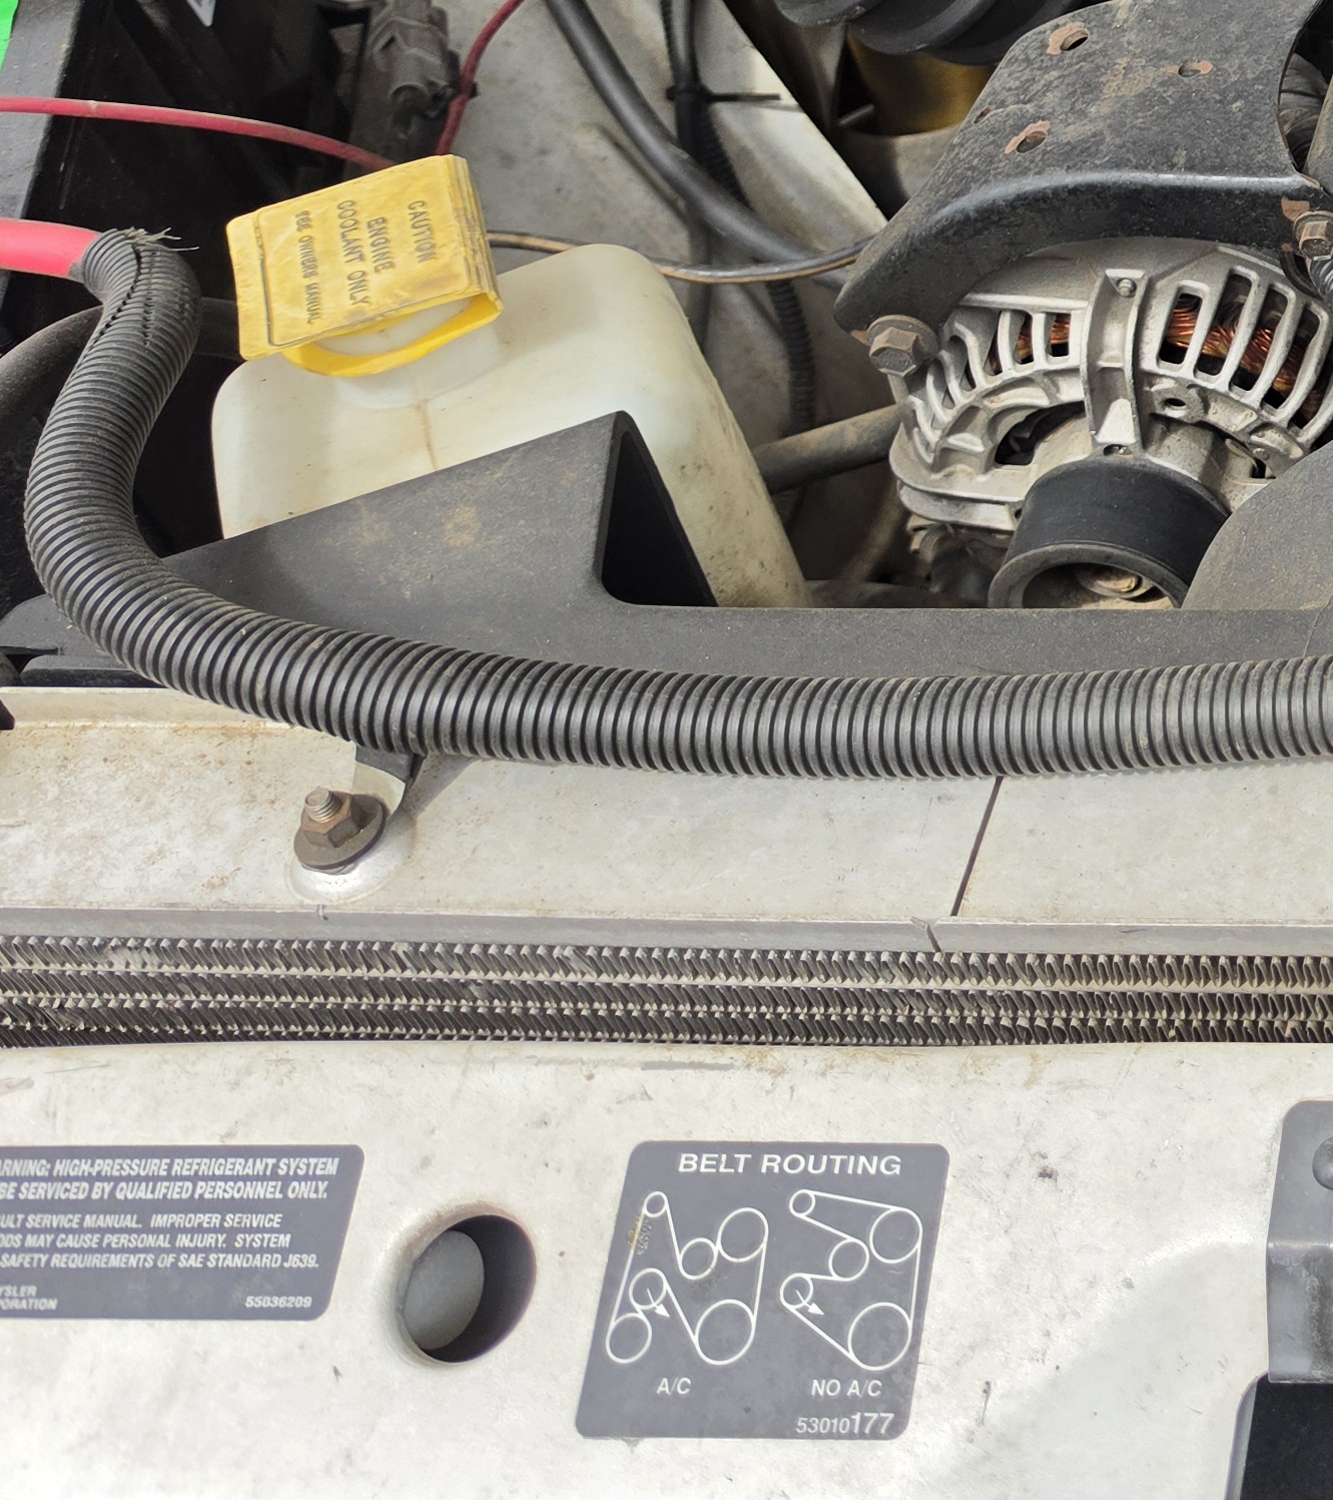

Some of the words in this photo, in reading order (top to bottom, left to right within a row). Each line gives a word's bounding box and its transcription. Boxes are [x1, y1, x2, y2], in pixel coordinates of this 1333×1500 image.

[336, 199, 366, 264] COOLANT
[406, 199, 440, 264] CAUTION
[366, 216, 396, 275] ENGINE
[346, 269, 371, 307] ONLY
[52, 1156, 171, 1178] HIGH-PRESSURE
[171, 1156, 277, 1178] REFRIGERANT
[277, 1156, 341, 1177] SYSTEM
[678, 1153, 753, 1174] BELT
[760, 1154, 903, 1176] ROUTING
[18, 1180, 90, 1201] SERVICED
[91, 1180, 114, 1201] BY
[114, 1180, 194, 1201] QUALIFIED
[194, 1180, 284, 1201] PERSONNEL
[286, 1180, 330, 1200] ONLY.
[25, 1212, 82, 1230] SERVICE
[83, 1212, 144, 1230] MANUAL.
[149, 1212, 221, 1230] IMPROPER
[222, 1212, 283, 1230] SERVICE
[24, 1232, 55, 1249] MAY
[55, 1232, 101, 1249] CAUSE
[102, 1232, 173, 1249] PERSONAL
[175, 1233, 228, 1249] INJURY.
[234, 1233, 292, 1249] SYSTEM
[0, 1252, 50, 1269] SAFETY
[50, 1252, 155, 1270] REQUIREMENTS
[156, 1253, 174, 1269] OF
[176, 1253, 206, 1269] SAE
[206, 1253, 282, 1269] STANDARD
[282, 1254, 321, 1270] J639.
[244, 1296, 313, 1310] 55036209
[656, 1376, 693, 1396] A/C
[810, 1379, 842, 1397] NO
[846, 1379, 884, 1397] A/C
[795, 1411, 896, 1436] 53010177
